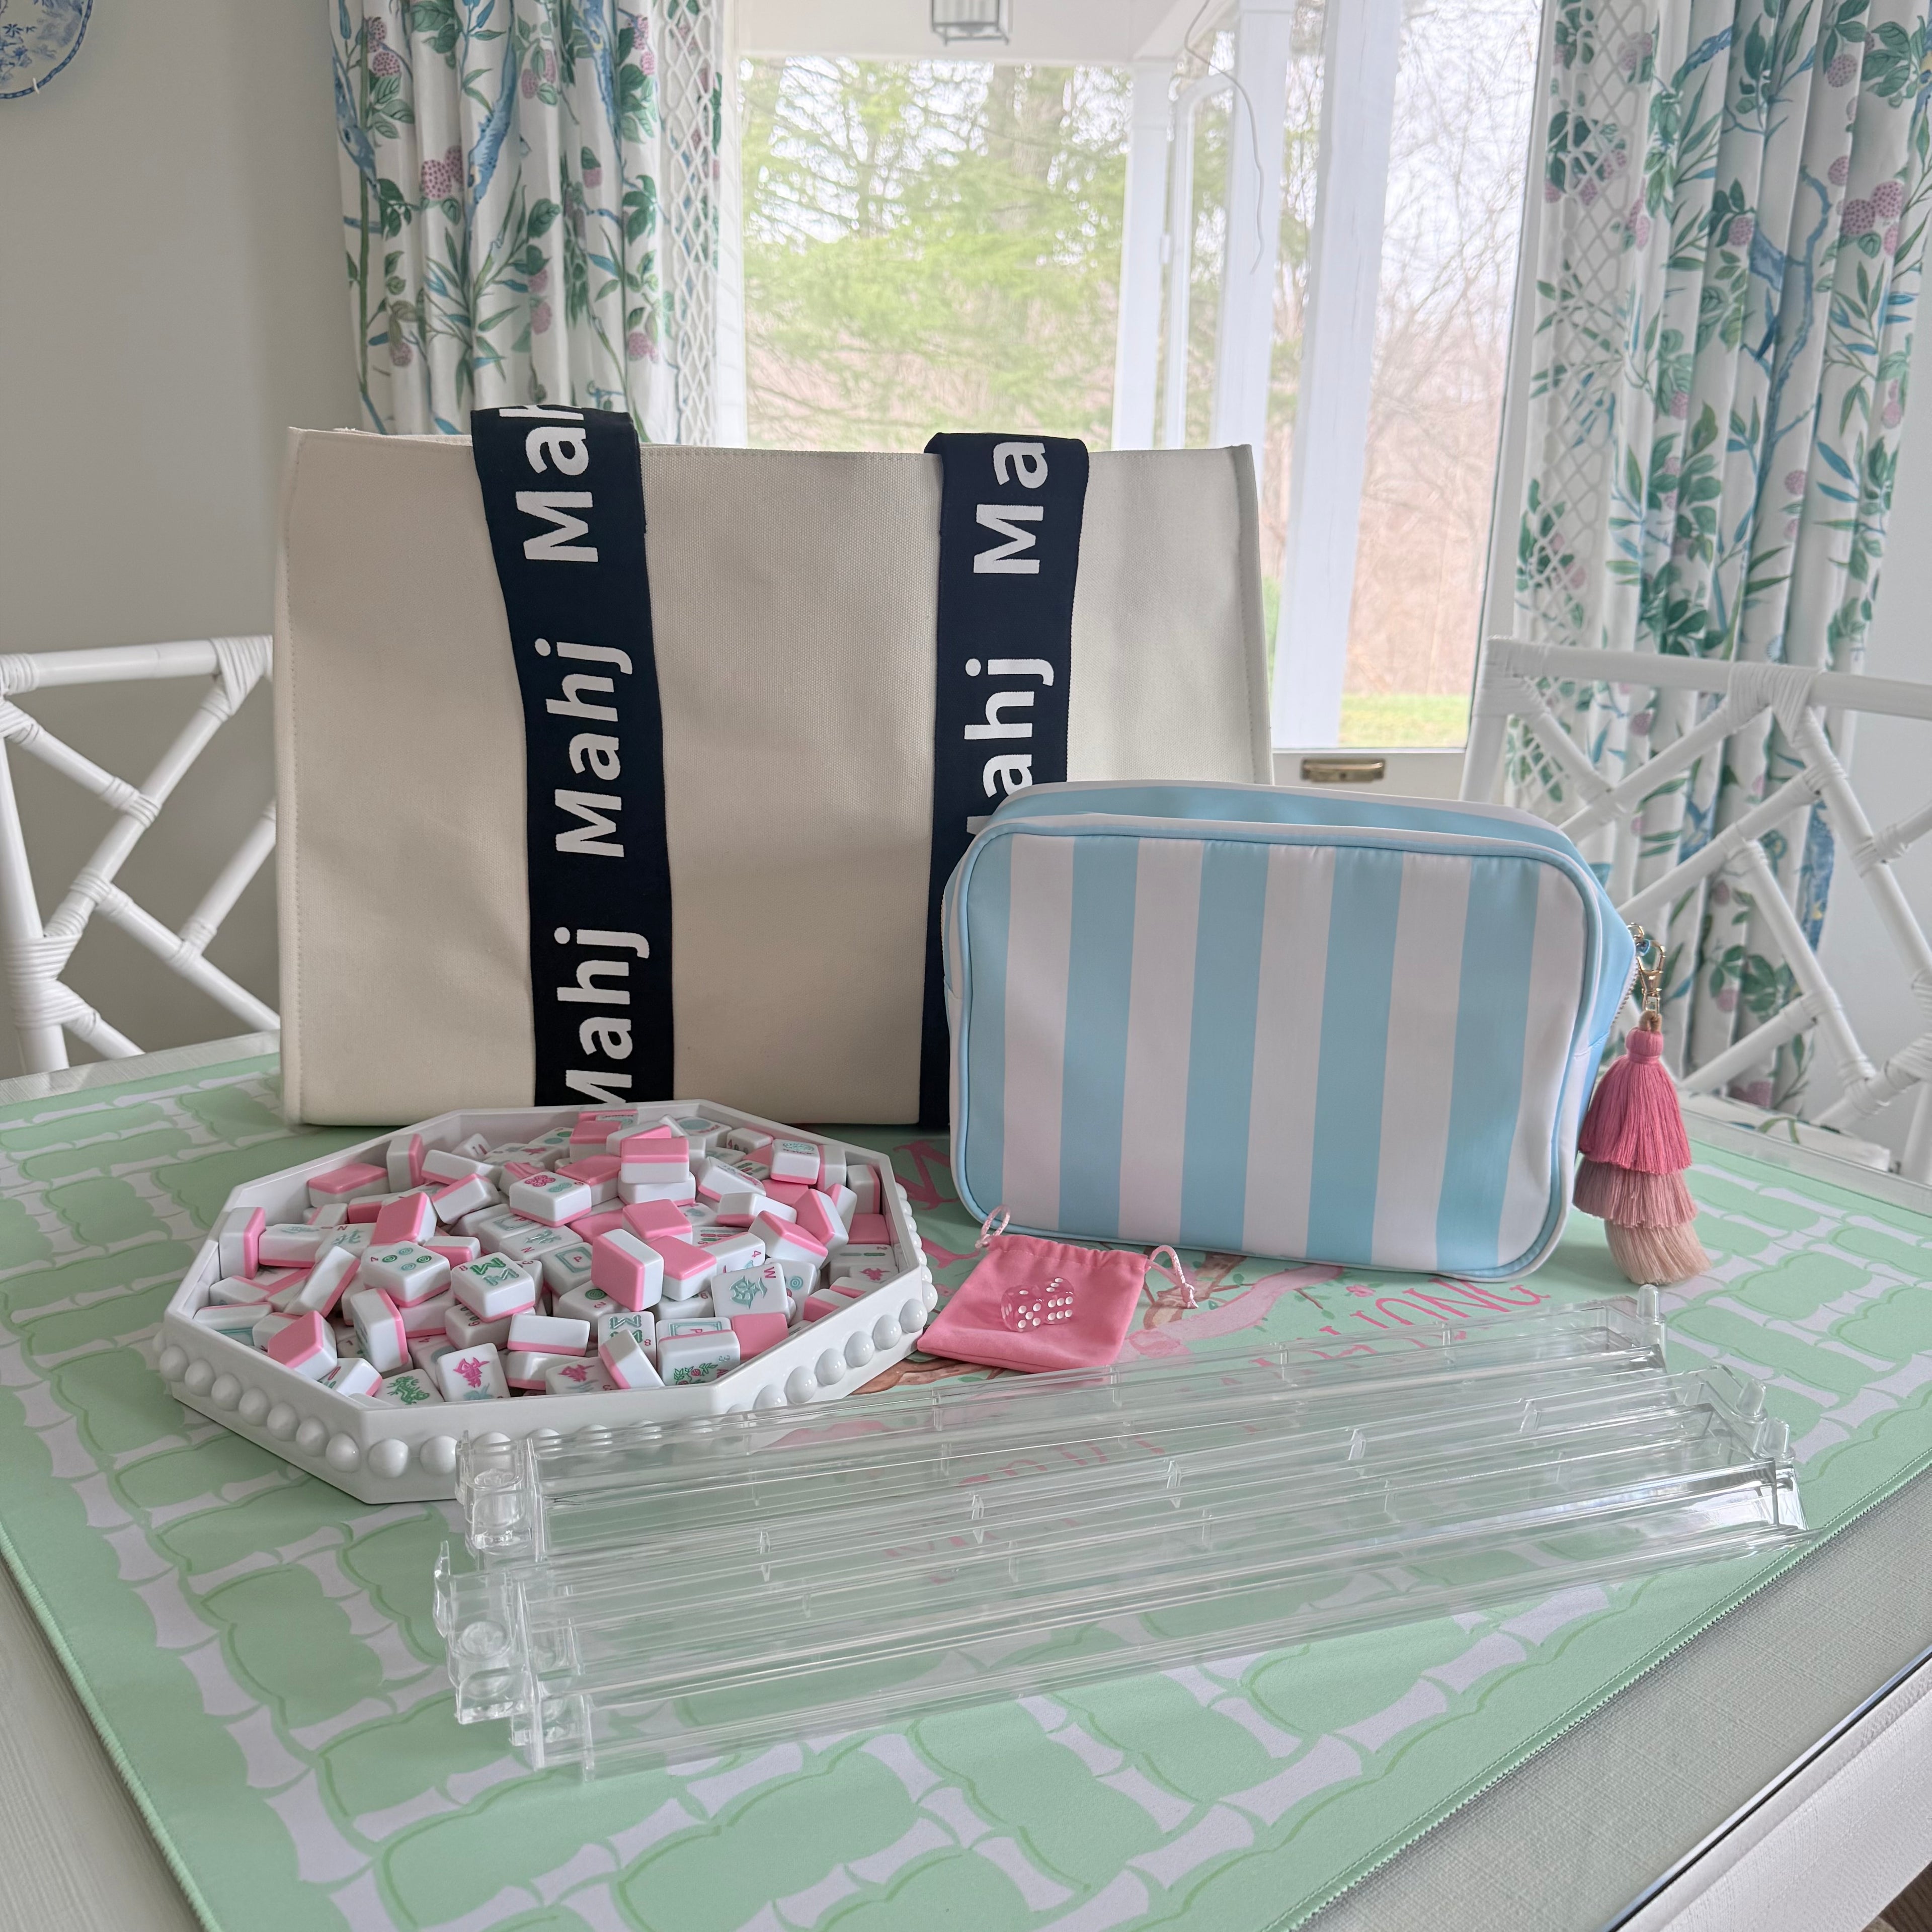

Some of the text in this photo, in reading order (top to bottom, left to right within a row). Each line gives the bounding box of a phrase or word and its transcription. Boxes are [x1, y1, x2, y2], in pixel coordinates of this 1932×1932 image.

[499, 406, 598, 562] Mah
[964, 442, 1054, 835] ahj Ma
[534, 638, 632, 857] Mahj
[764, 1266, 776, 1278] W
